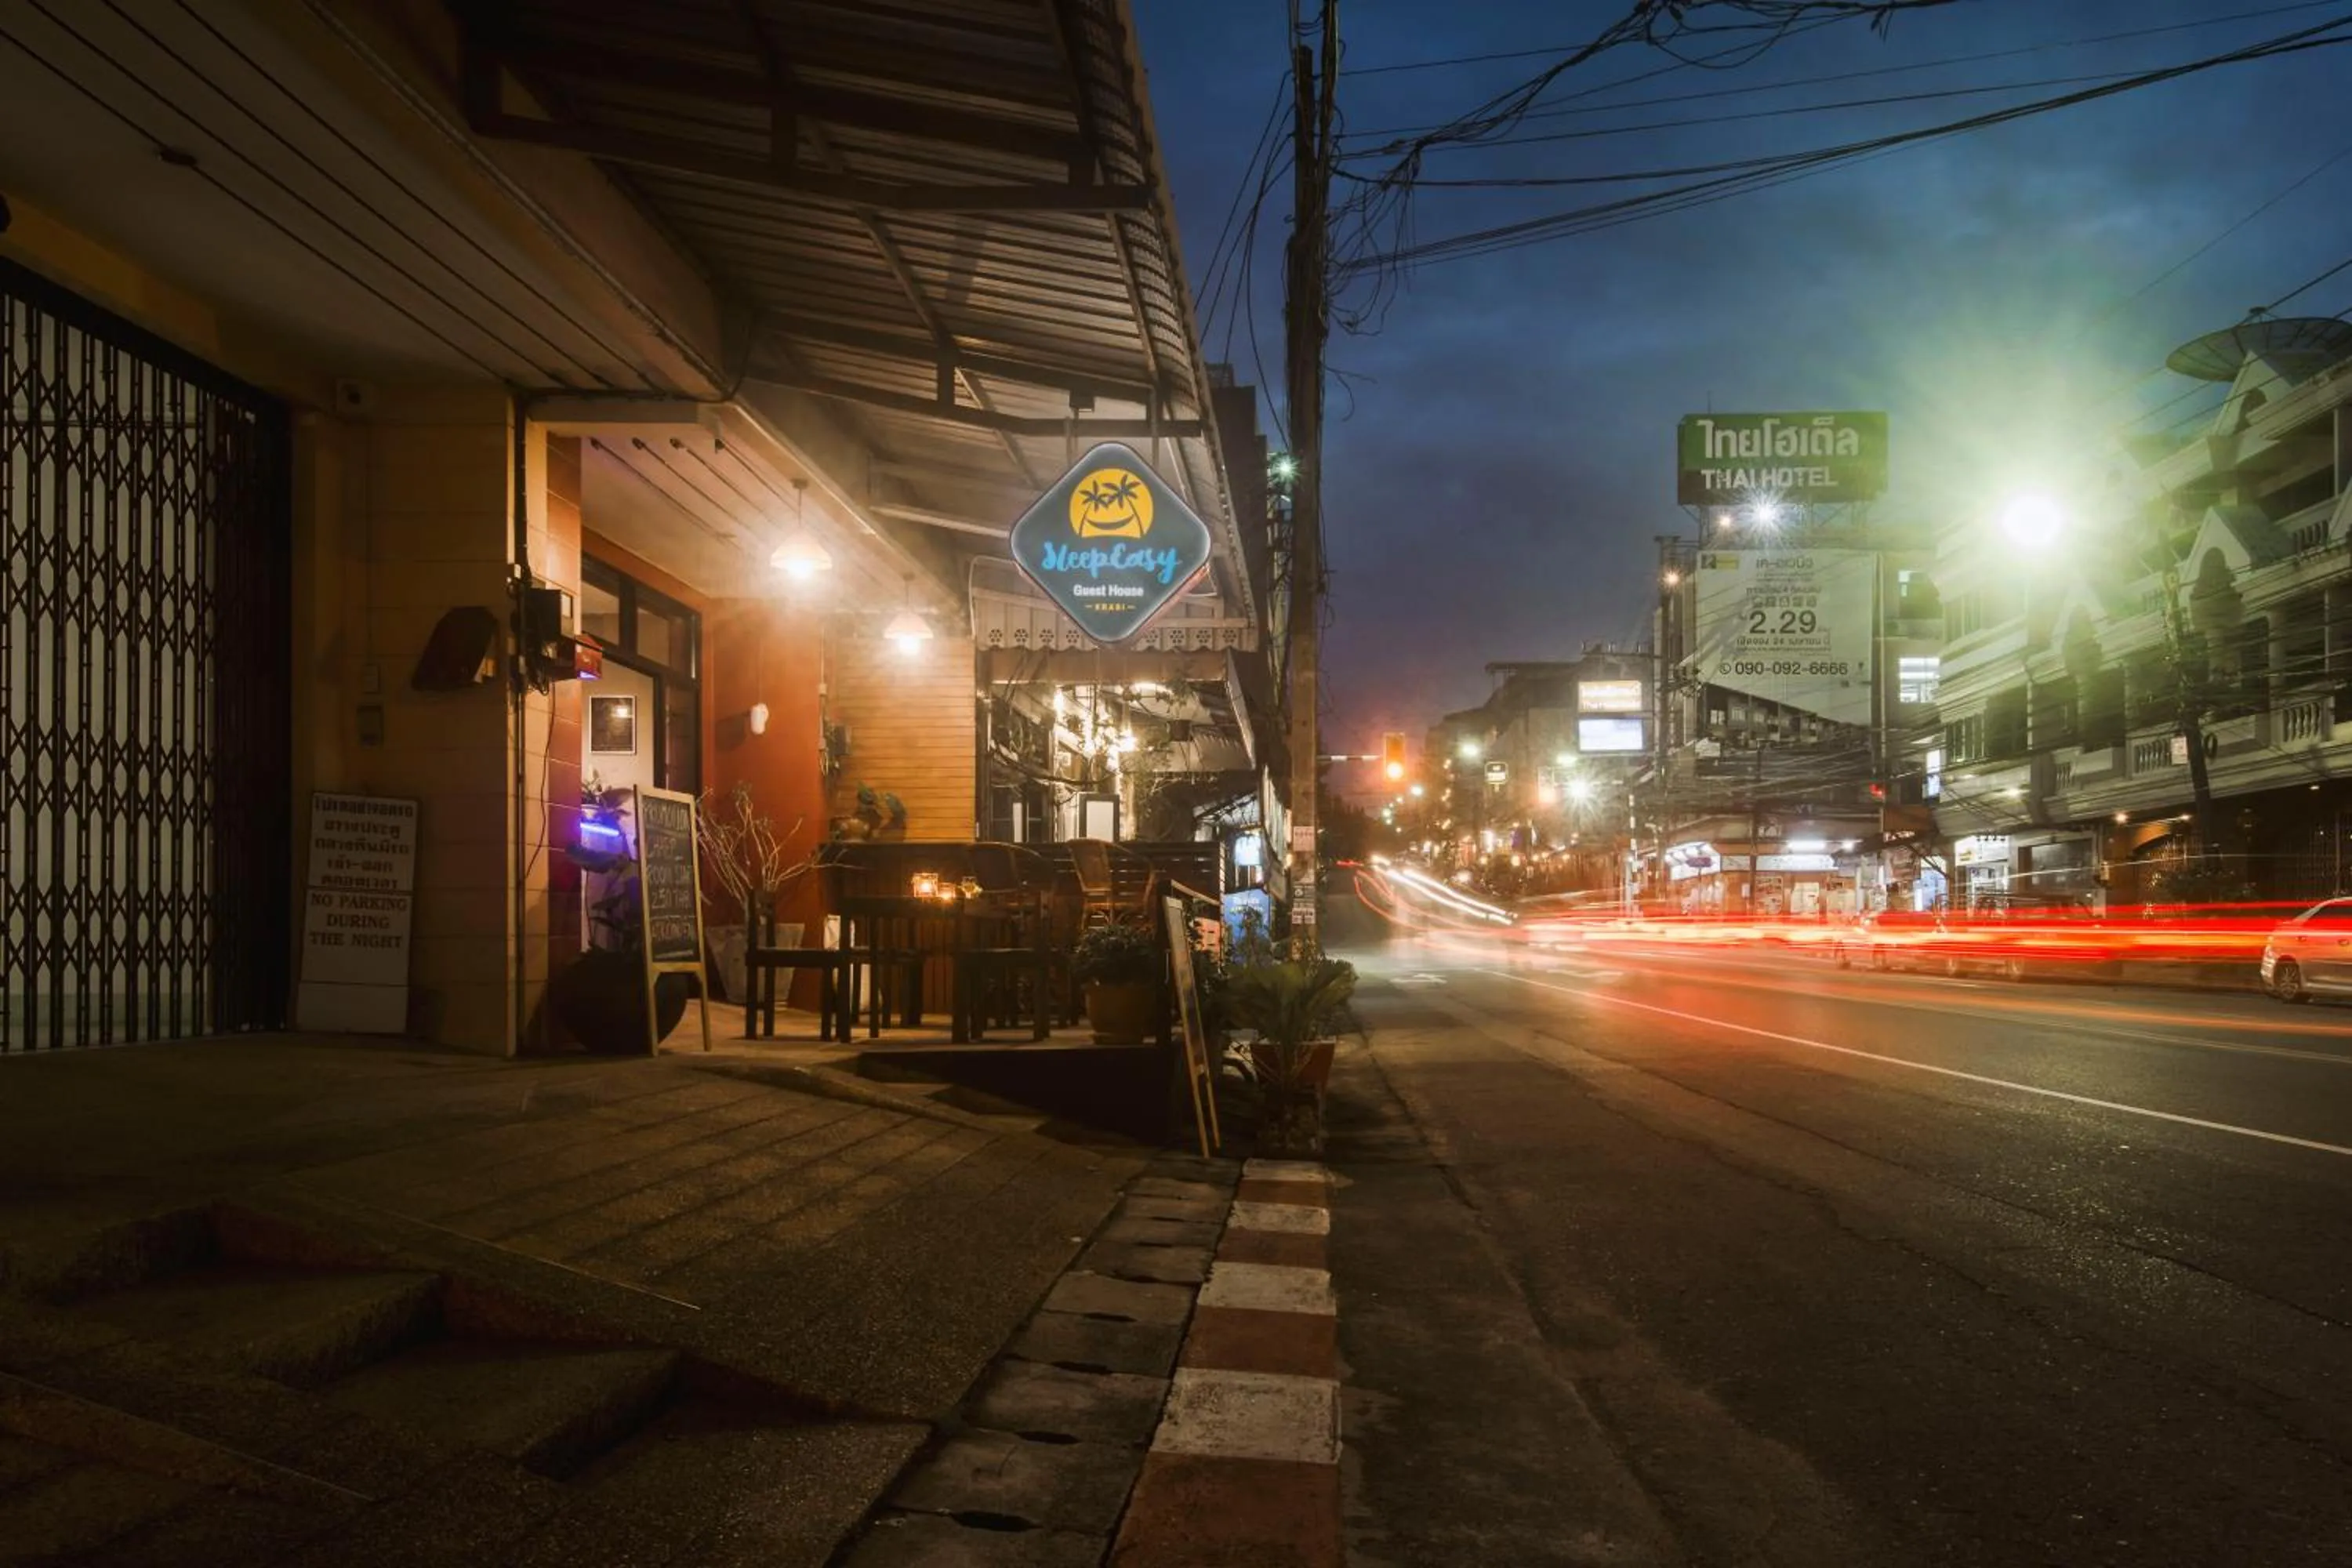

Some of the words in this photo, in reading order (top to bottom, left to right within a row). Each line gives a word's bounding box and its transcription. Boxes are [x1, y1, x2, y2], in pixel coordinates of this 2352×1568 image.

[1700, 469, 1756, 489] THAI
[1759, 466, 1838, 488] HOTEL
[1073, 584, 1106, 597] Guest
[1108, 584, 1145, 597] House
[1749, 610, 1817, 634] 2.29
[311, 892, 333, 907] NO
[339, 895, 408, 912] PARKING
[326, 913, 390, 929] DURING
[309, 931, 346, 947] THE
[350, 932, 404, 949] NIGHT
